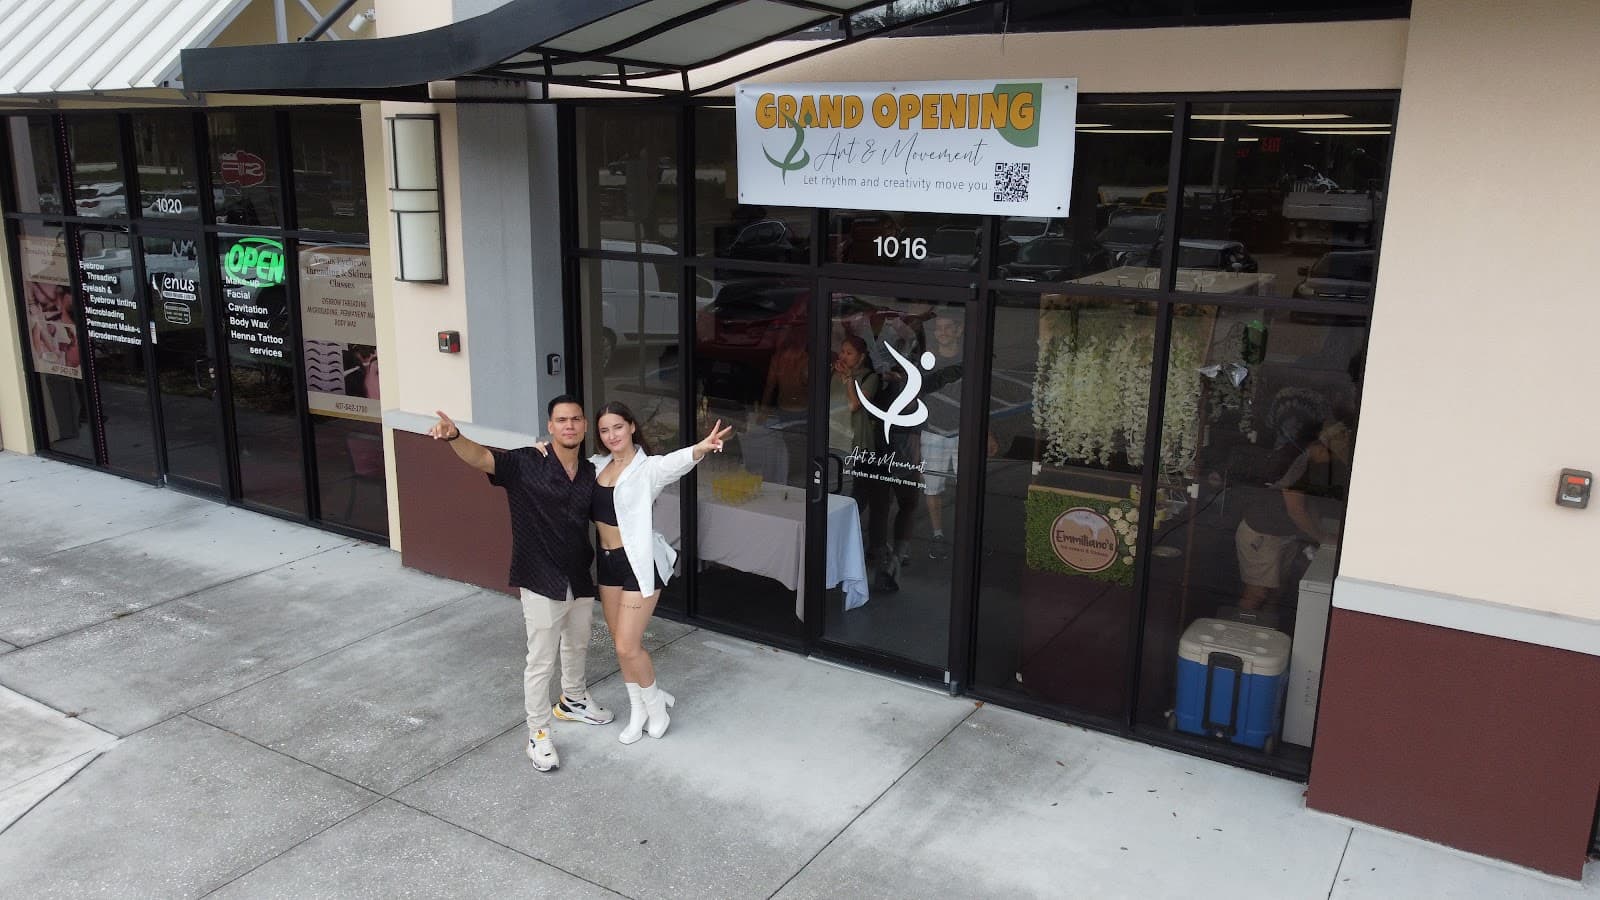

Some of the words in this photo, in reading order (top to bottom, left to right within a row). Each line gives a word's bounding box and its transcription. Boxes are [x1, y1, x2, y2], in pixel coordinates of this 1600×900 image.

[755, 93, 864, 129] GRAND
[872, 92, 1035, 131] OPENING
[814, 132, 859, 172] Art
[861, 139, 876, 163] &
[881, 132, 988, 175] Movement
[803, 175, 818, 185] Let
[821, 176, 856, 188] rhythm
[860, 177, 880, 187] and
[883, 177, 932, 191] creativity
[935, 182, 964, 192] move
[157, 198, 182, 214] 1020
[873, 236, 927, 260] 1016
[79, 261, 105, 270] Eyebrow
[229, 244, 285, 284] OPEN
[87, 271, 117, 284] Threading
[82, 283, 106, 293] Eyelash
[107, 286, 113, 294] &
[227, 290, 250, 300] Facial
[90, 295, 116, 304] Eyebrow
[85, 306, 125, 320] Microblading
[228, 302, 268, 314] Cavitation
[87, 318, 118, 330] Permanent
[230, 317, 249, 328] Body
[250, 319, 269, 329] Wax
[231, 331, 256, 342] Henna
[258, 333, 283, 345] Tattoo
[249, 347, 283, 358] services
[845, 446, 868, 466] Art
[868, 451, 877, 464] &
[878, 451, 927, 473] Movement
[880, 476, 901, 485] creativity
[1056, 530, 1114, 551] Emmiliano's
